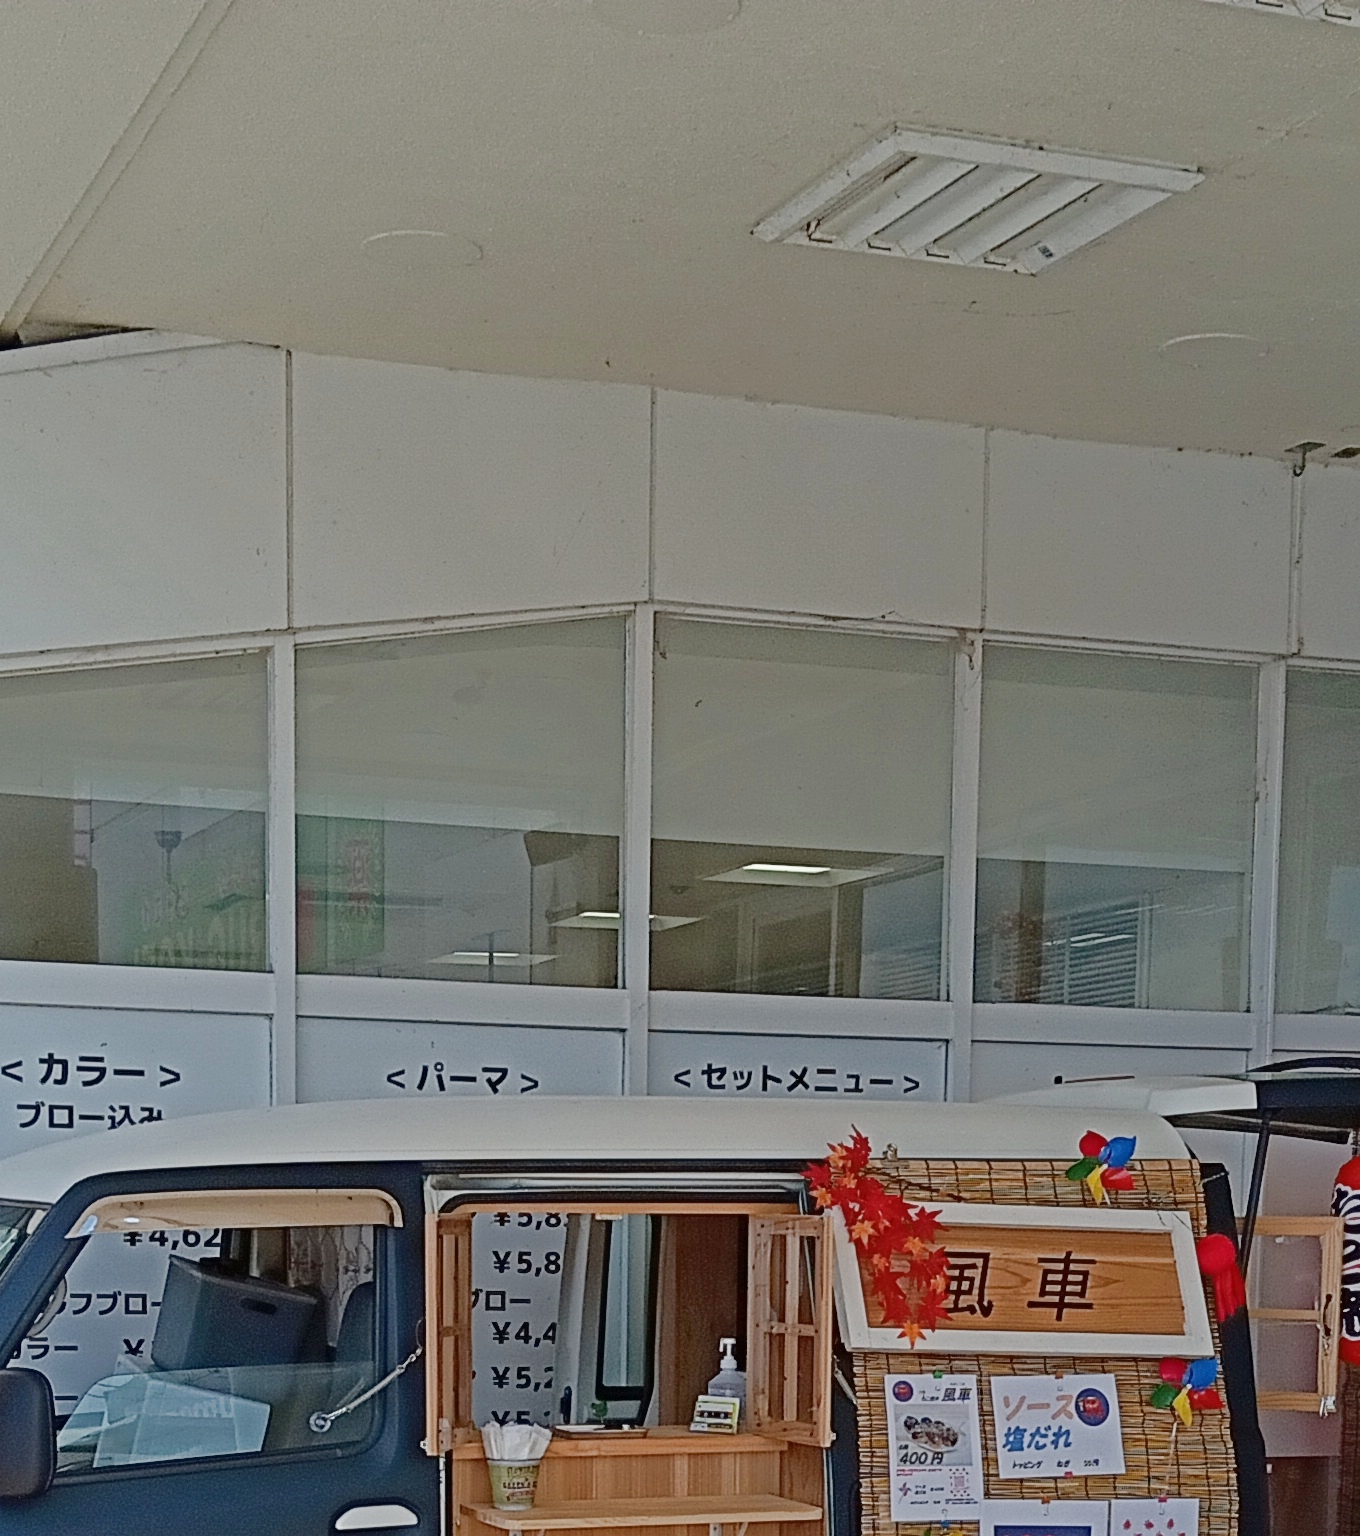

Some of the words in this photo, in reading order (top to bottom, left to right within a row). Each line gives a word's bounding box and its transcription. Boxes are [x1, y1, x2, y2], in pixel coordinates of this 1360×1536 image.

[945, 1250, 1097, 1322] 風車
[1003, 1395, 1074, 1421] ソース
[1002, 1425, 1072, 1452] 塩だれ
[899, 1452, 944, 1465] 400円
